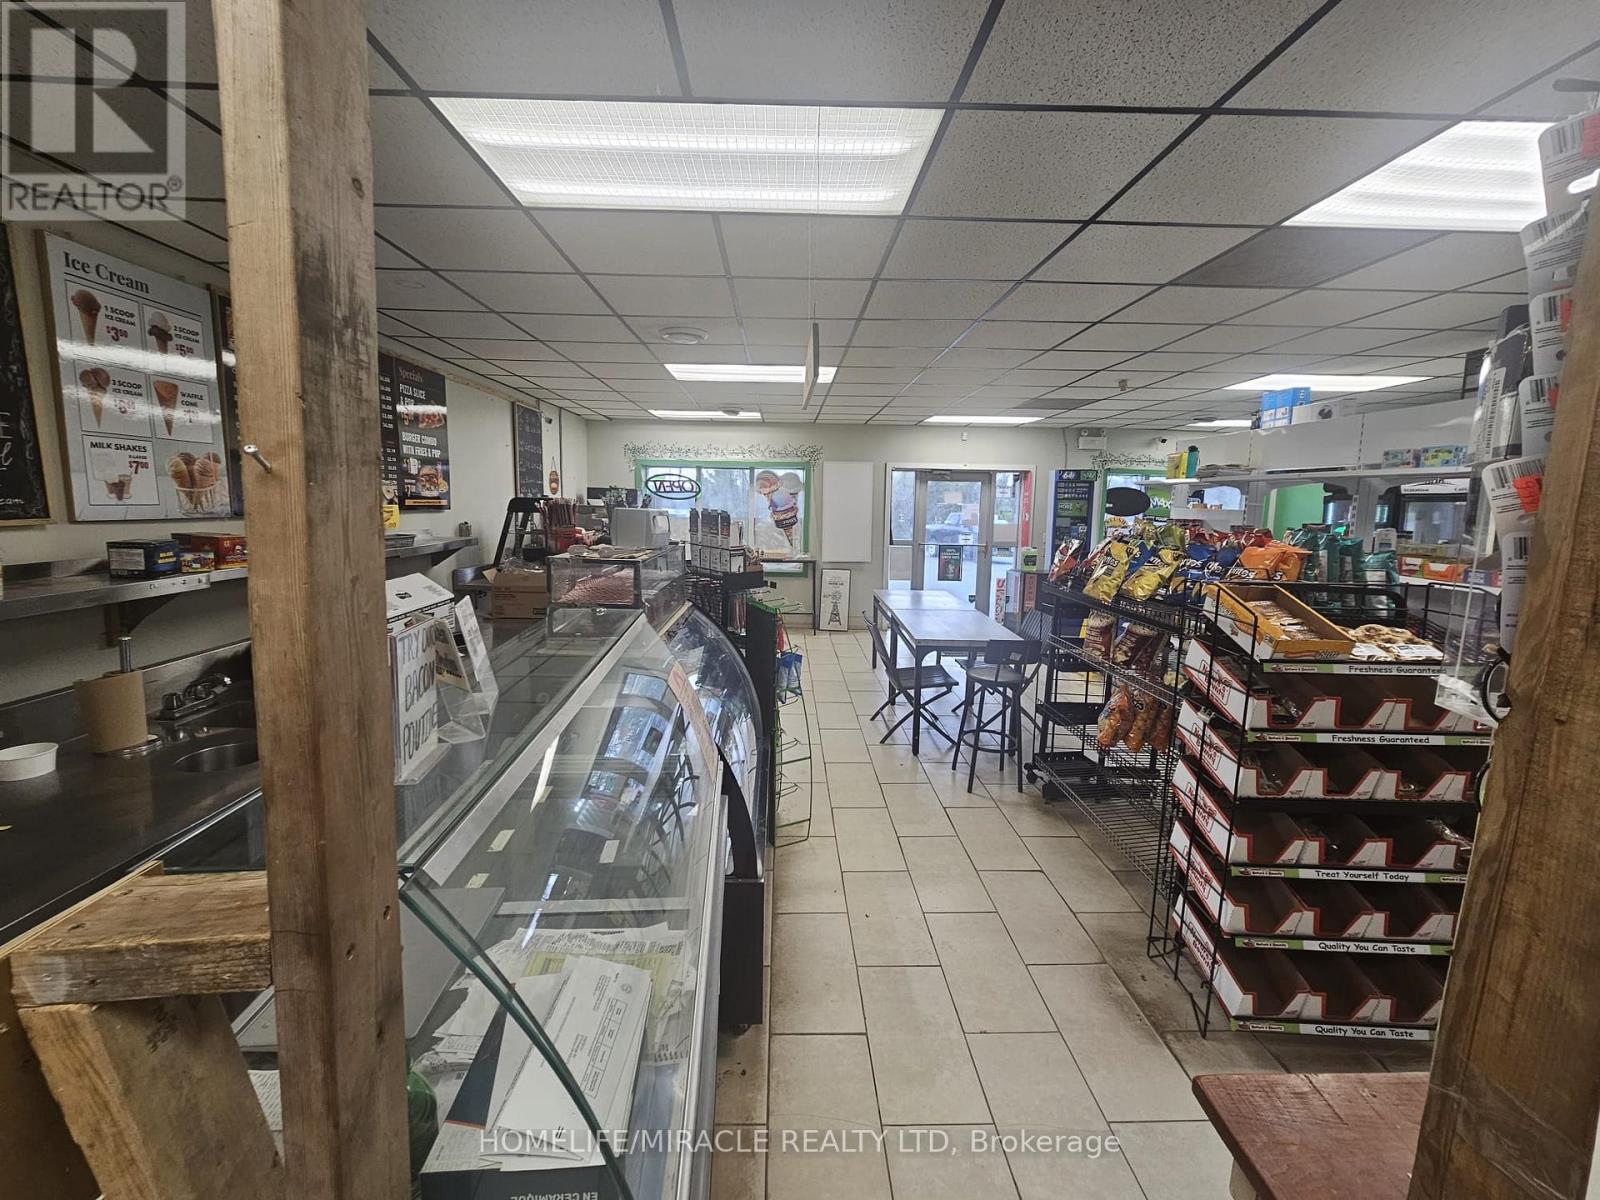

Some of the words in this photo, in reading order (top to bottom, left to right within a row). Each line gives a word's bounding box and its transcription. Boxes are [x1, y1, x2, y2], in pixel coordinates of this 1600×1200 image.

[63, 251, 91, 274] Ice
[95, 263, 150, 294] Cream
[110, 307, 135, 318] SCOOP
[115, 316, 136, 326] CREAM
[179, 327, 200, 336] SCOOP
[118, 380, 142, 389] SCOOP
[180, 391, 204, 401] WAFFLE
[399, 383, 412, 396] PIZZA
[413, 387, 426, 400] SLICE
[401, 431, 420, 443] BURGER
[90, 441, 112, 449] MILK
[114, 443, 147, 452] SHAKES
[402, 444, 415, 455] WITH
[415, 446, 428, 457] FRIES
[432, 449, 441, 458] POP
[398, 630, 420, 664] TRY
[405, 660, 435, 713] BACON
[1379, 736, 1430, 744] Guaranteed
[1315, 870, 1340, 878] Treat
[1343, 871, 1379, 879] Yourself
[1383, 872, 1410, 882] Today
[1318, 942, 1351, 952] Quality
[1353, 943, 1369, 951] You
[1372, 944, 1388, 952] Can
[1391, 945, 1416, 953] Taste
[1315, 1025, 1348, 1036] Quality
[1351, 1027, 1367, 1035] You
[1370, 1028, 1386, 1036] Can
[1389, 1029, 1414, 1038] Taste
